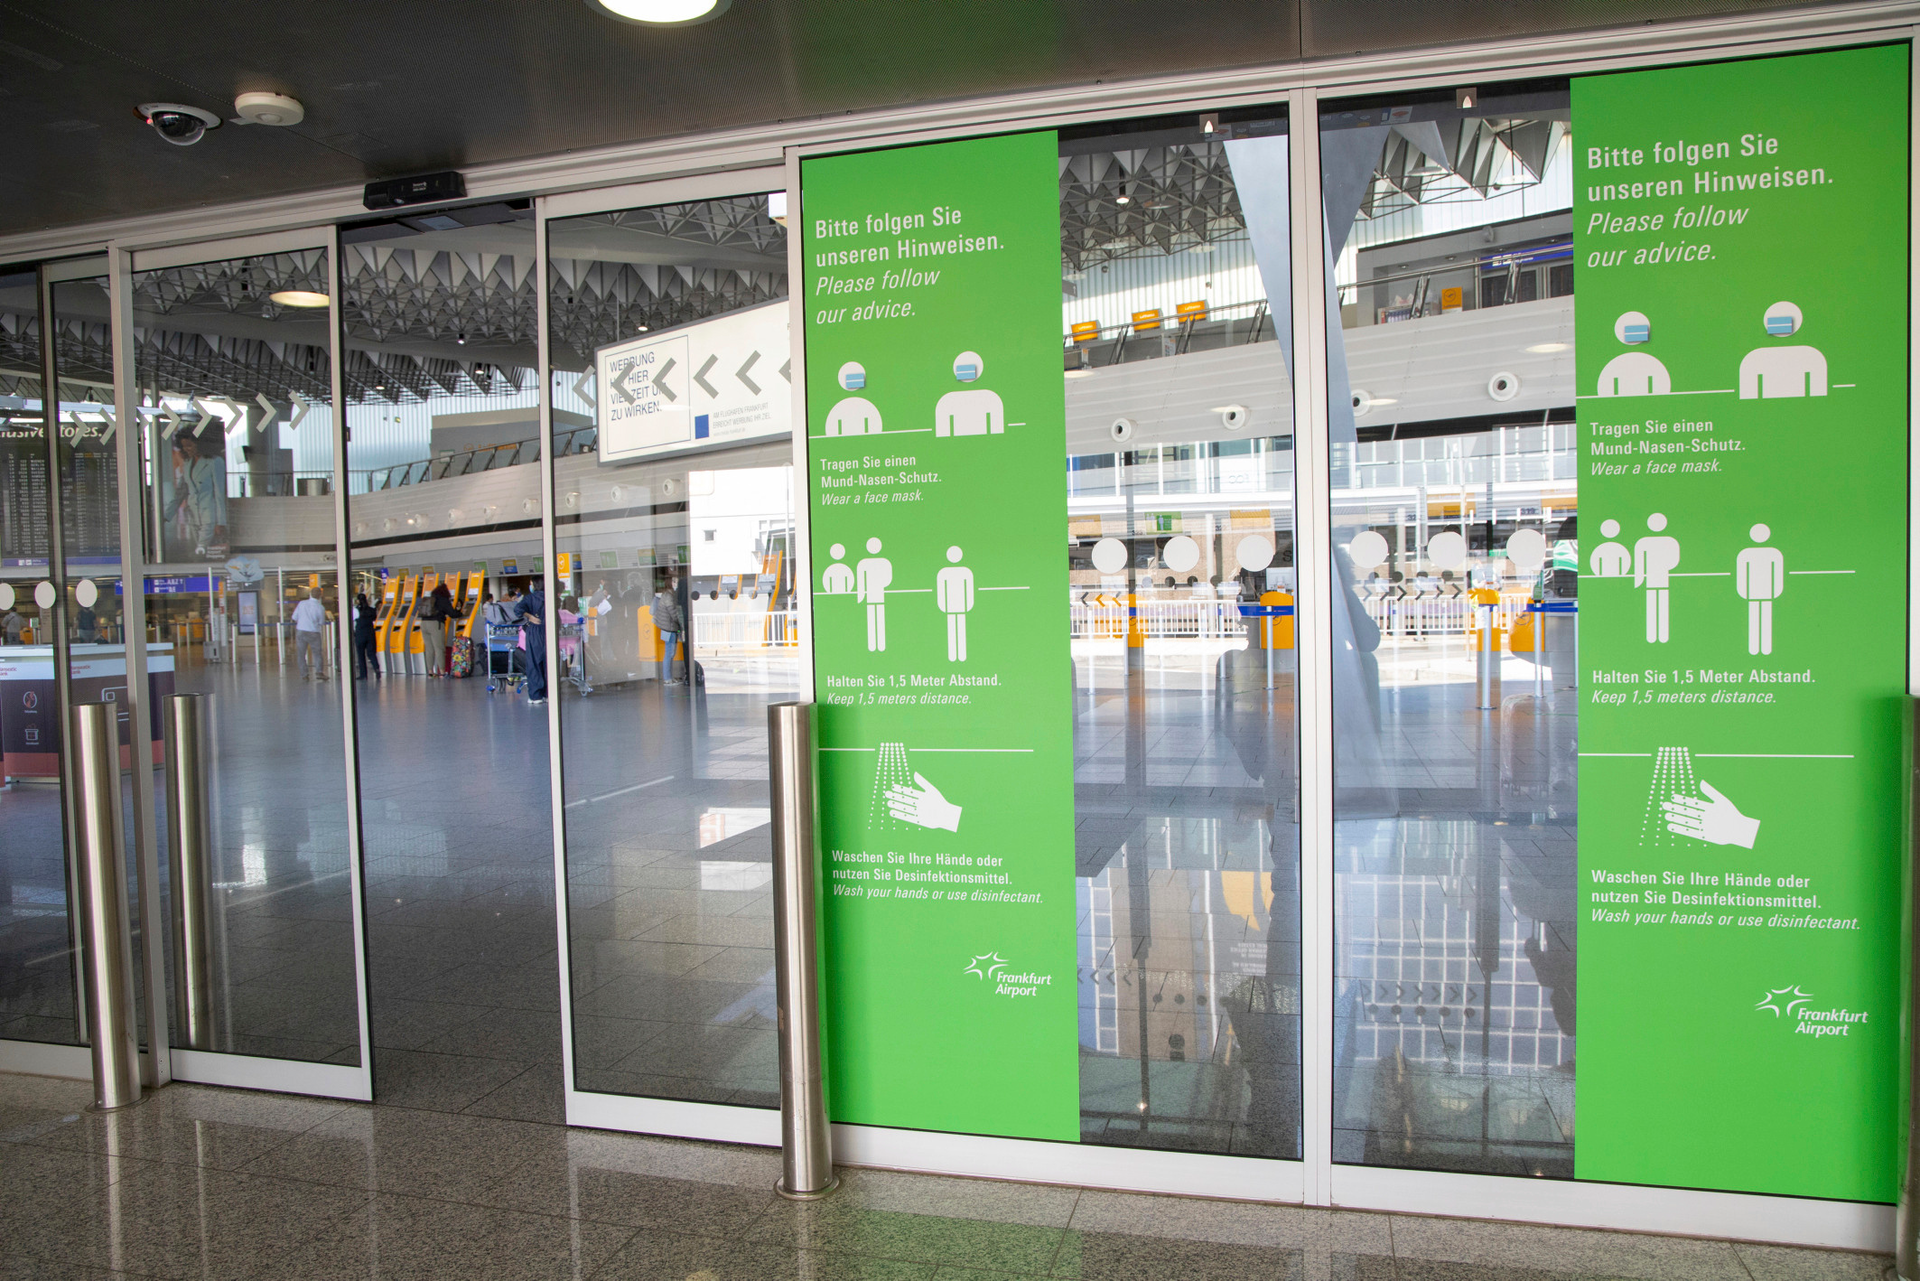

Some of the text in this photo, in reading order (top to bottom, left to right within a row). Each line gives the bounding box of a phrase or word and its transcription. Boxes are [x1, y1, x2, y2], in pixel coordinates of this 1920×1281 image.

[1587, 134, 1778, 169] Bitte folgen Sie
[1588, 166, 1833, 202] unseren Hinweisen.
[814, 206, 961, 239] Bitte folgen Sie
[1587, 205, 1749, 235] Please follow
[816, 234, 1004, 267] unseren Hinweisen.
[1587, 240, 1716, 268] our advice.
[815, 268, 940, 296] Please follow
[814, 299, 915, 323] our advice.
[611, 392, 627, 405] VIE
[611, 408, 622, 421] ZU
[1589, 419, 1713, 438] Tragen Sie einen
[1590, 438, 1745, 455] Mund-Nasen-Schutz.
[821, 455, 916, 472] Tragen Sie einen
[1590, 458, 1721, 475] Wear a face mask.
[821, 471, 942, 488] Mund-Nasen-Schutz.
[819, 489, 923, 506] Wear a face mask.
[827, 674, 1001, 688] Halten Sie 1,5 Meter Abstand.
[1592, 669, 1815, 684] Halten Sie 1,5 Meter Abstand.
[827, 692, 971, 706] Keep 1,5 meters distance.
[1591, 690, 1776, 706] Keep 1,5 meters distance.
[832, 850, 1003, 867] Waschen Sie Ihre Hände oder
[833, 867, 1012, 884] nutzen Sie Desinfektionsmittel.
[1591, 870, 1810, 888] Waschen Sie Ihre Hände oder
[833, 885, 1043, 903] Wash your hands or use disinfectant.
[1591, 890, 1821, 908] nutzen Sie Desinfektionsmittel.
[1591, 908, 1861, 931] Wash your hands or use disinfectant.
[997, 971, 1052, 986] Frankfurt
[995, 983, 1037, 998] Airport
[1797, 1007, 1869, 1024] Frankfurt
[1795, 1022, 1850, 1039] Airport
